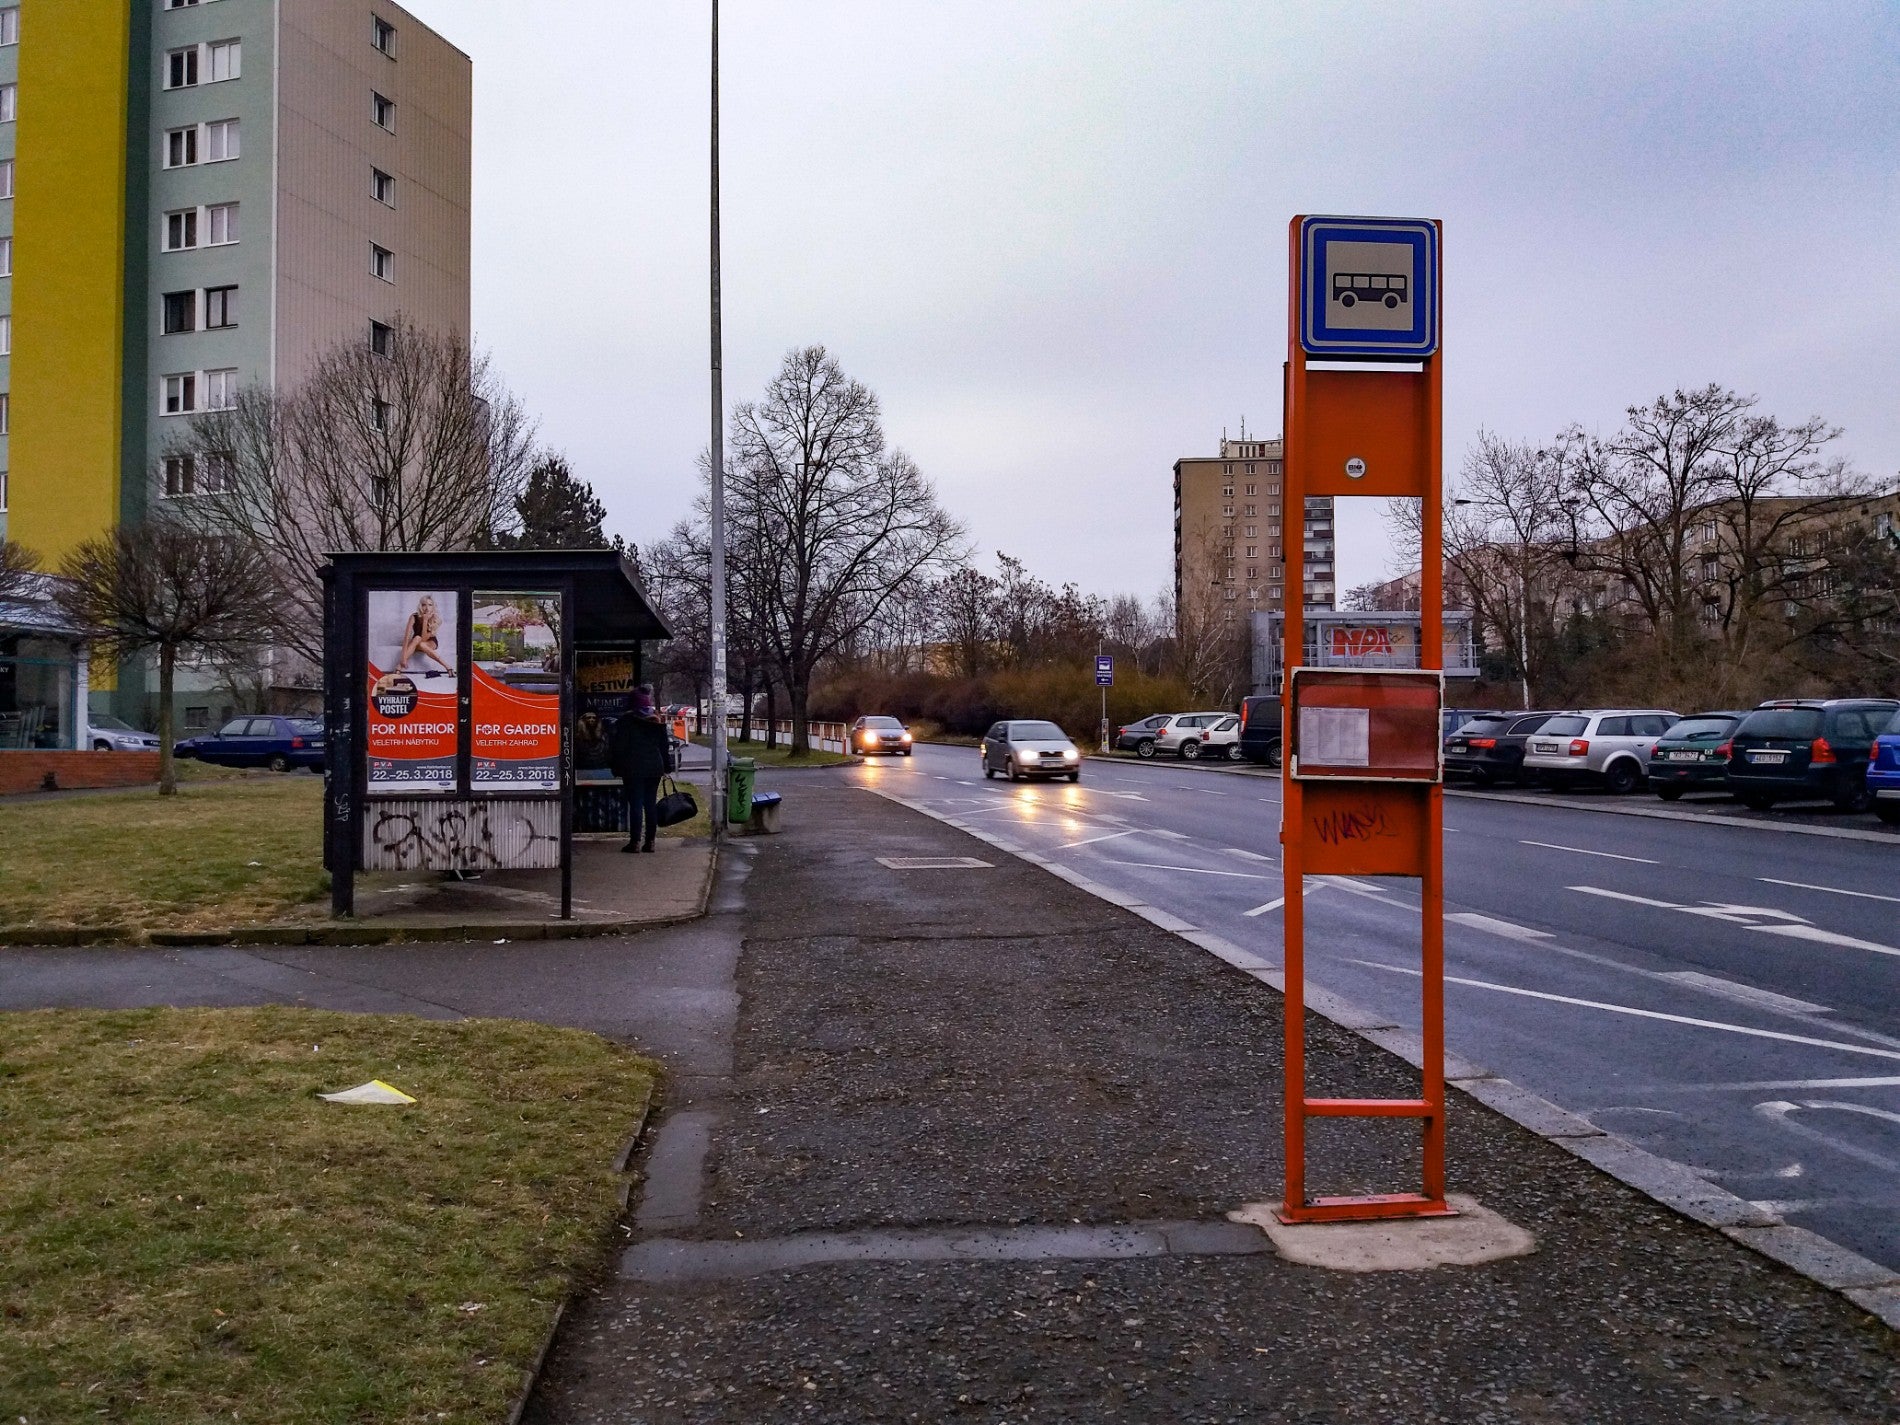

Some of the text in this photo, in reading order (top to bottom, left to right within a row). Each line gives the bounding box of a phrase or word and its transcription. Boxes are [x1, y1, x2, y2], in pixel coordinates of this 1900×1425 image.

[380, 704, 408, 714] POSTEL
[372, 724, 455, 735] FOR INTERIOR
[475, 724, 556, 735] FOR GARDEN
[405, 737, 439, 746] NÁBYTKU
